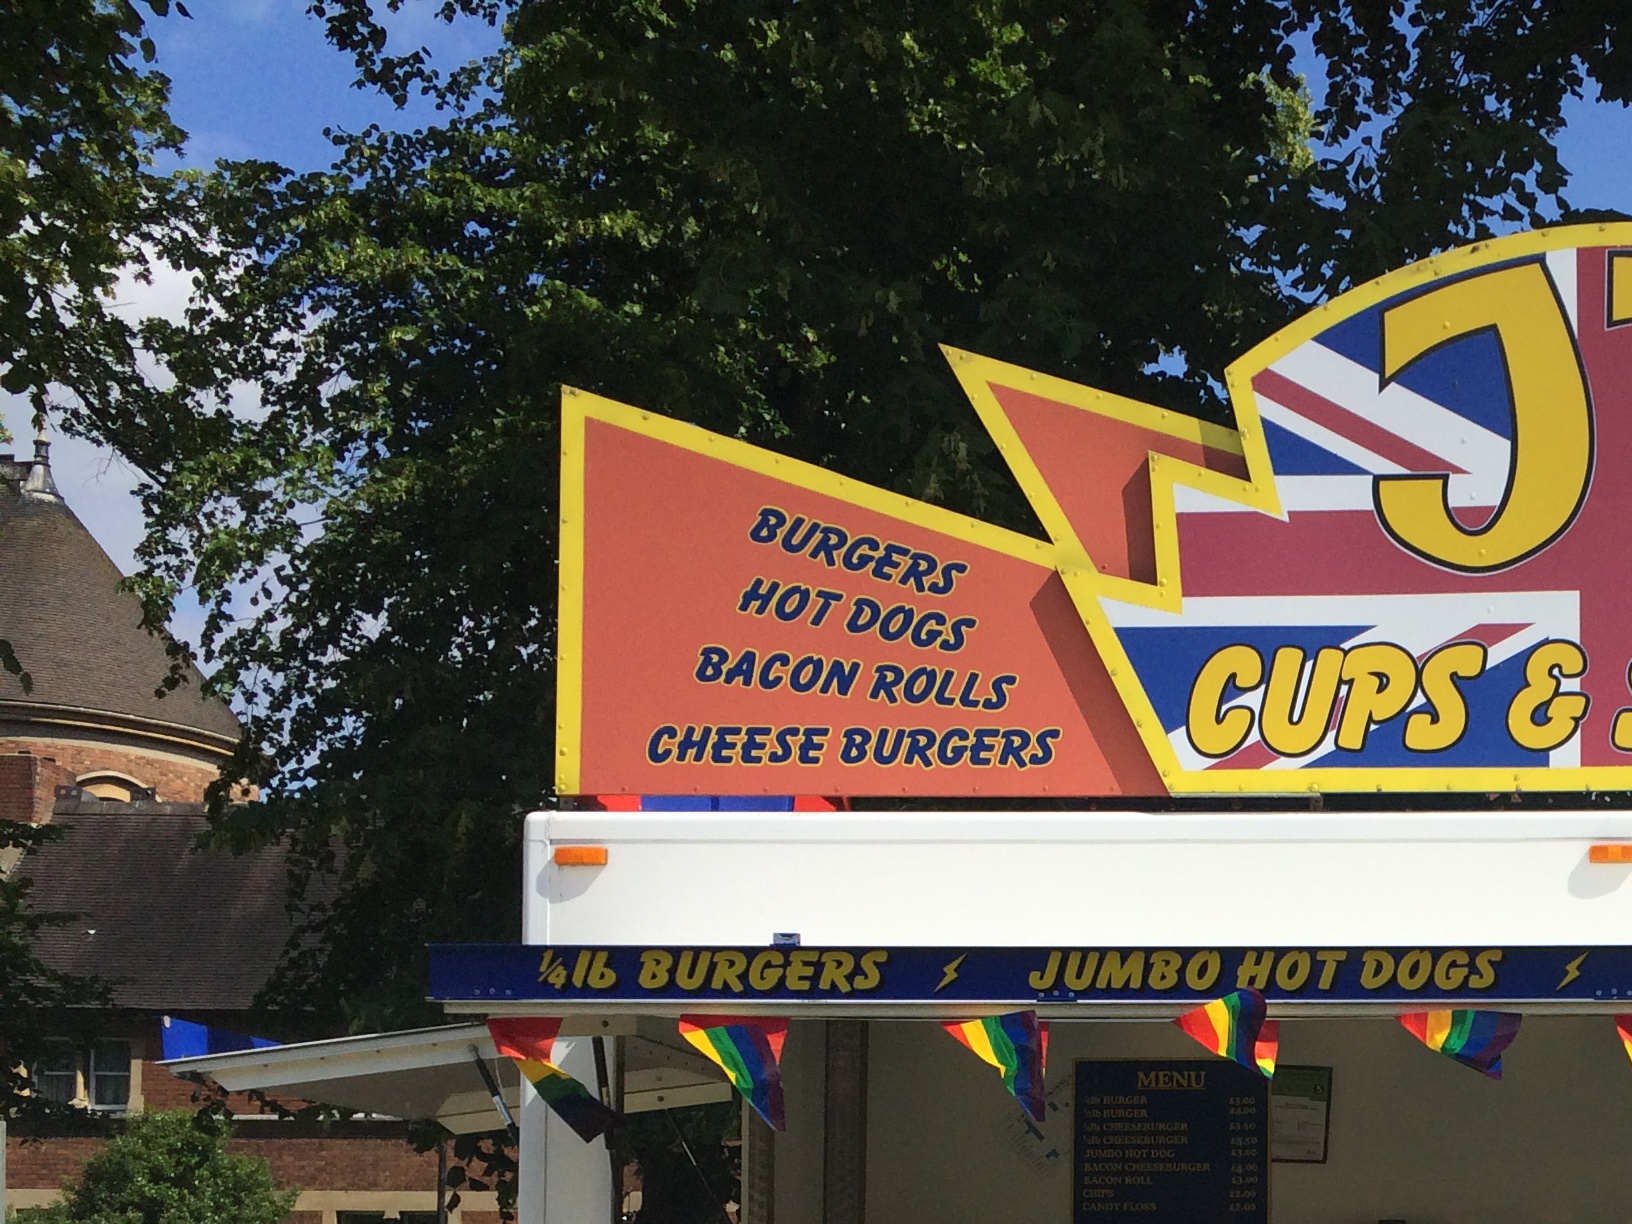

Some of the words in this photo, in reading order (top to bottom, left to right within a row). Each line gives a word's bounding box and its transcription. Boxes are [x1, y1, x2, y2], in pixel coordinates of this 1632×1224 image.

[748, 506, 969, 597] BURGERS
[738, 576, 845, 628] HOT
[847, 600, 978, 654] DOGS
[693, 645, 859, 700] BACON
[868, 661, 1019, 712] ROLLS
[1186, 640, 1488, 757] CUPS
[1507, 638, 1590, 752] &
[646, 723, 831, 766] CHEESE
[839, 725, 1062, 771] BURGERS
[638, 949, 890, 993] BURGERS
[1028, 949, 1221, 991] JUMBO
[1236, 949, 1346, 991] HOT
[1361, 949, 1502, 991] DOGS
[1136, 1071, 1206, 1089] MENU
[1103, 1095, 1148, 1104] BURGER
[1102, 1109, 1148, 1118] BURGER
[1103, 1122, 1188, 1131] CHEESEBURGER
[1103, 1136, 1188, 1145] CHEESEBURGER
[1084, 1149, 1122, 1158] JUMBO
[1125, 1149, 1148, 1158] HOT
[1150, 1149, 1175, 1158] DOG
[1083, 1162, 1122, 1172] BACON
[1125, 1162, 1210, 1172] CHEESEBURGER
[1083, 1176, 1122, 1185] BACON
[1125, 1176, 1153, 1185] ROLL
[1082, 1202, 1121, 1212] CANDY
[1123, 1202, 1156, 1212] FLOSS
